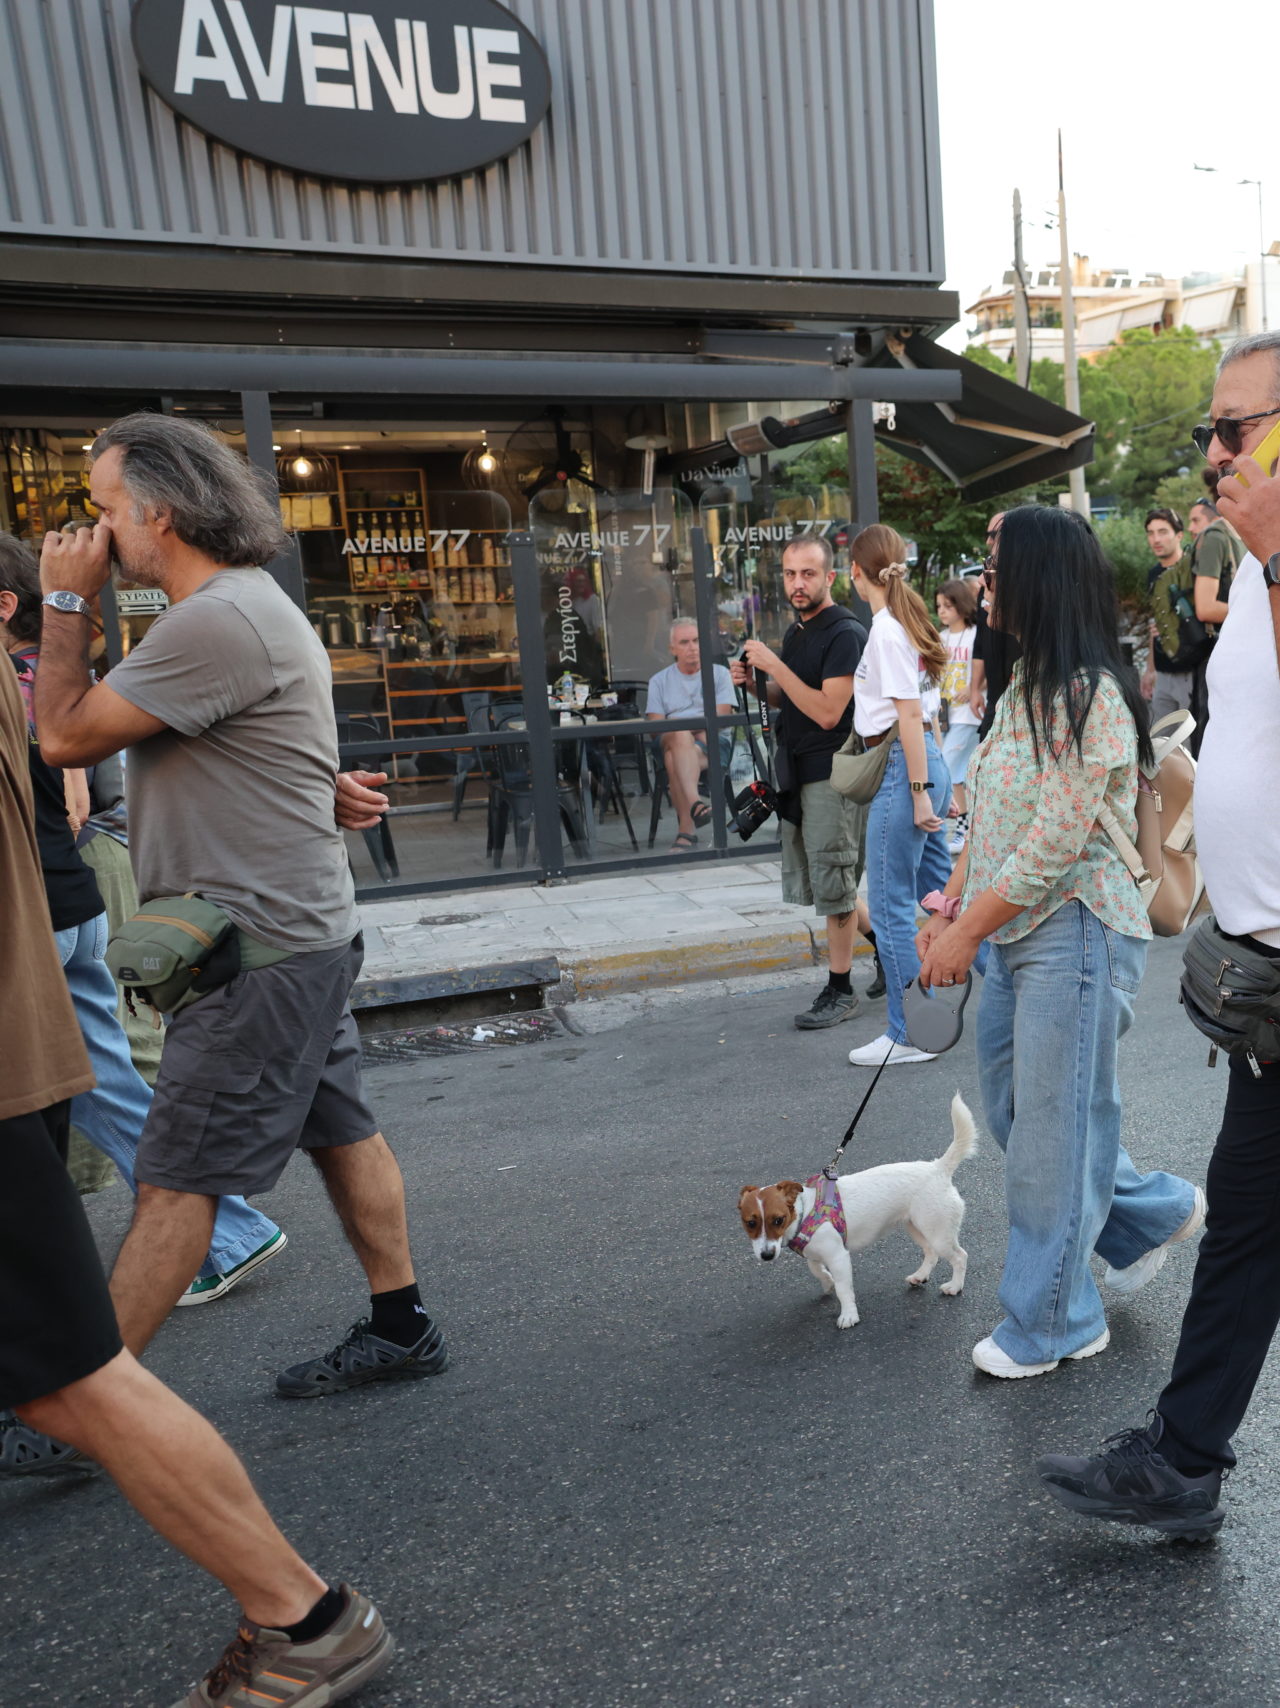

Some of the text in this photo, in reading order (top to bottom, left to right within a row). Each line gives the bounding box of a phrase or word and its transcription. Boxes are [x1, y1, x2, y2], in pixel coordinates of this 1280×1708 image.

[174, 0, 527, 124] AVENUE
[341, 528, 471, 555] AVENUE 77
[554, 530, 630, 548] AVENUE
[632, 524, 671, 546] 77
[724, 525, 794, 543] AVENUE
[760, 700, 768, 726] SONY
[143, 957, 161, 970] CAT
